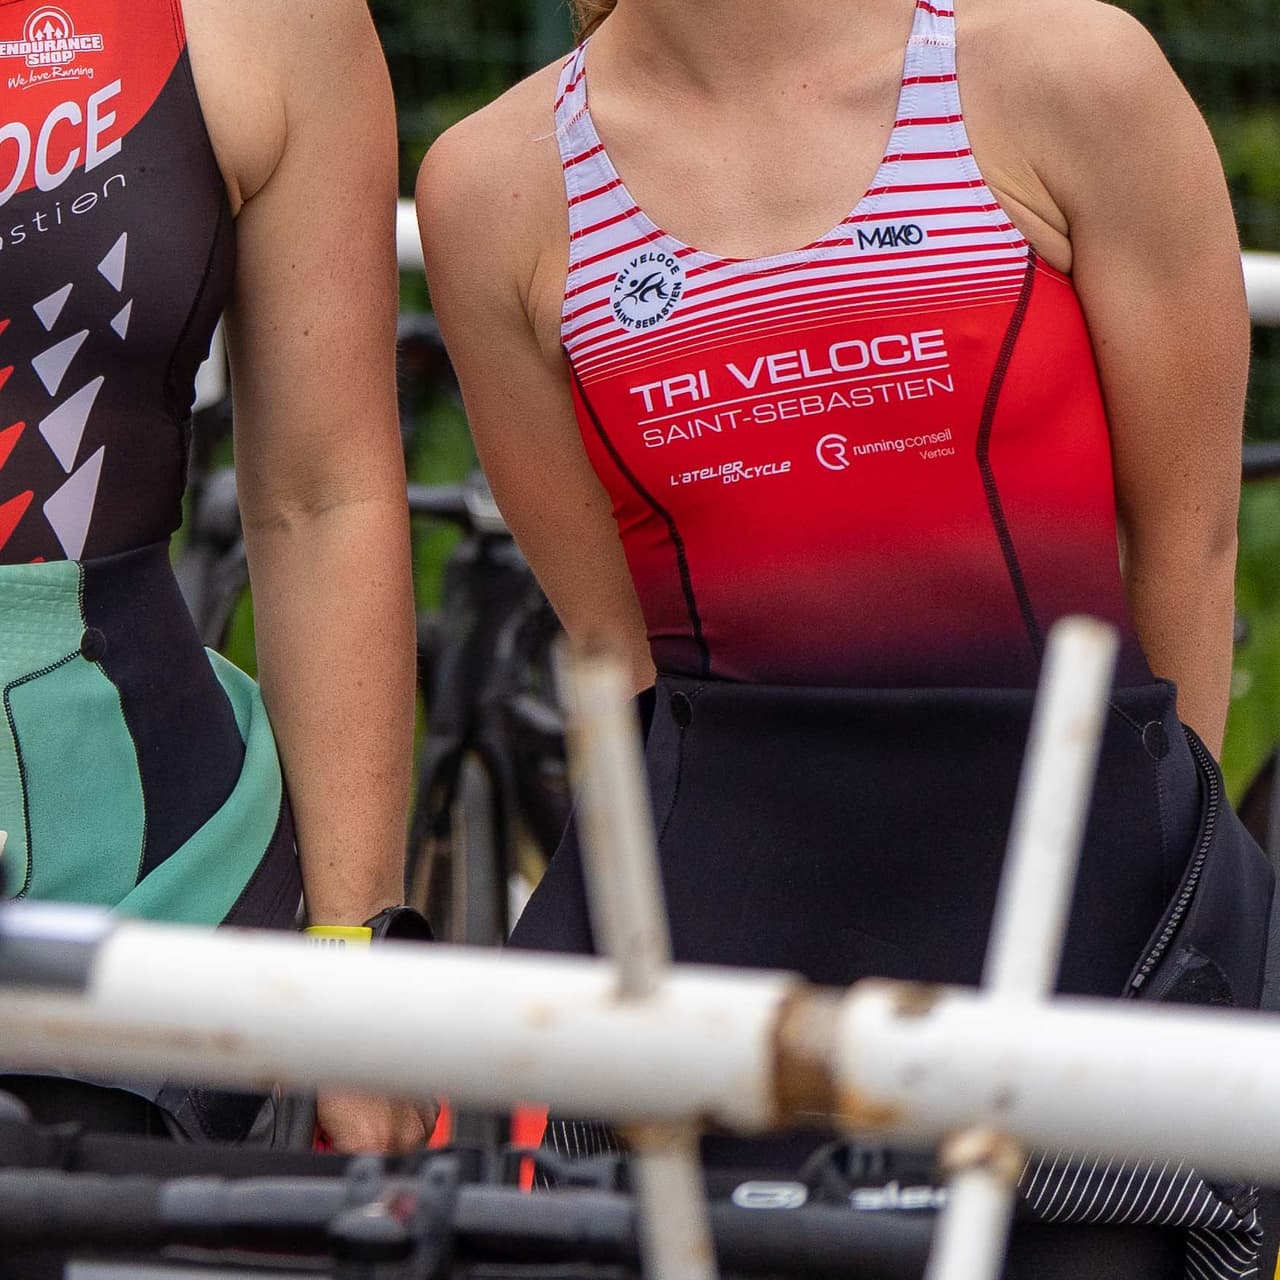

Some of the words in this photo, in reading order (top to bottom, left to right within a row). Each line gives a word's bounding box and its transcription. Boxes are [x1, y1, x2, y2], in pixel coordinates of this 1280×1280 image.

[27, 51, 74, 66] SHOP
[8, 73, 28, 89] We
[29, 69, 51, 83] love
[51, 65, 94, 80] Running
[857, 224, 923, 250] MAKO
[614, 269, 629, 293] TRI
[630, 252, 680, 275] VELOCE
[613, 301, 634, 327] SAINT
[635, 282, 682, 329] SEBASTIEN
[629, 369, 710, 413] TRI
[726, 328, 948, 389] VELOCE
[642, 374, 955, 449] SAINT-SEBASTIEN
[852, 428, 953, 457] runningconseil
[920, 446, 956, 461] Vertou
[723, 472, 740, 485] DU
